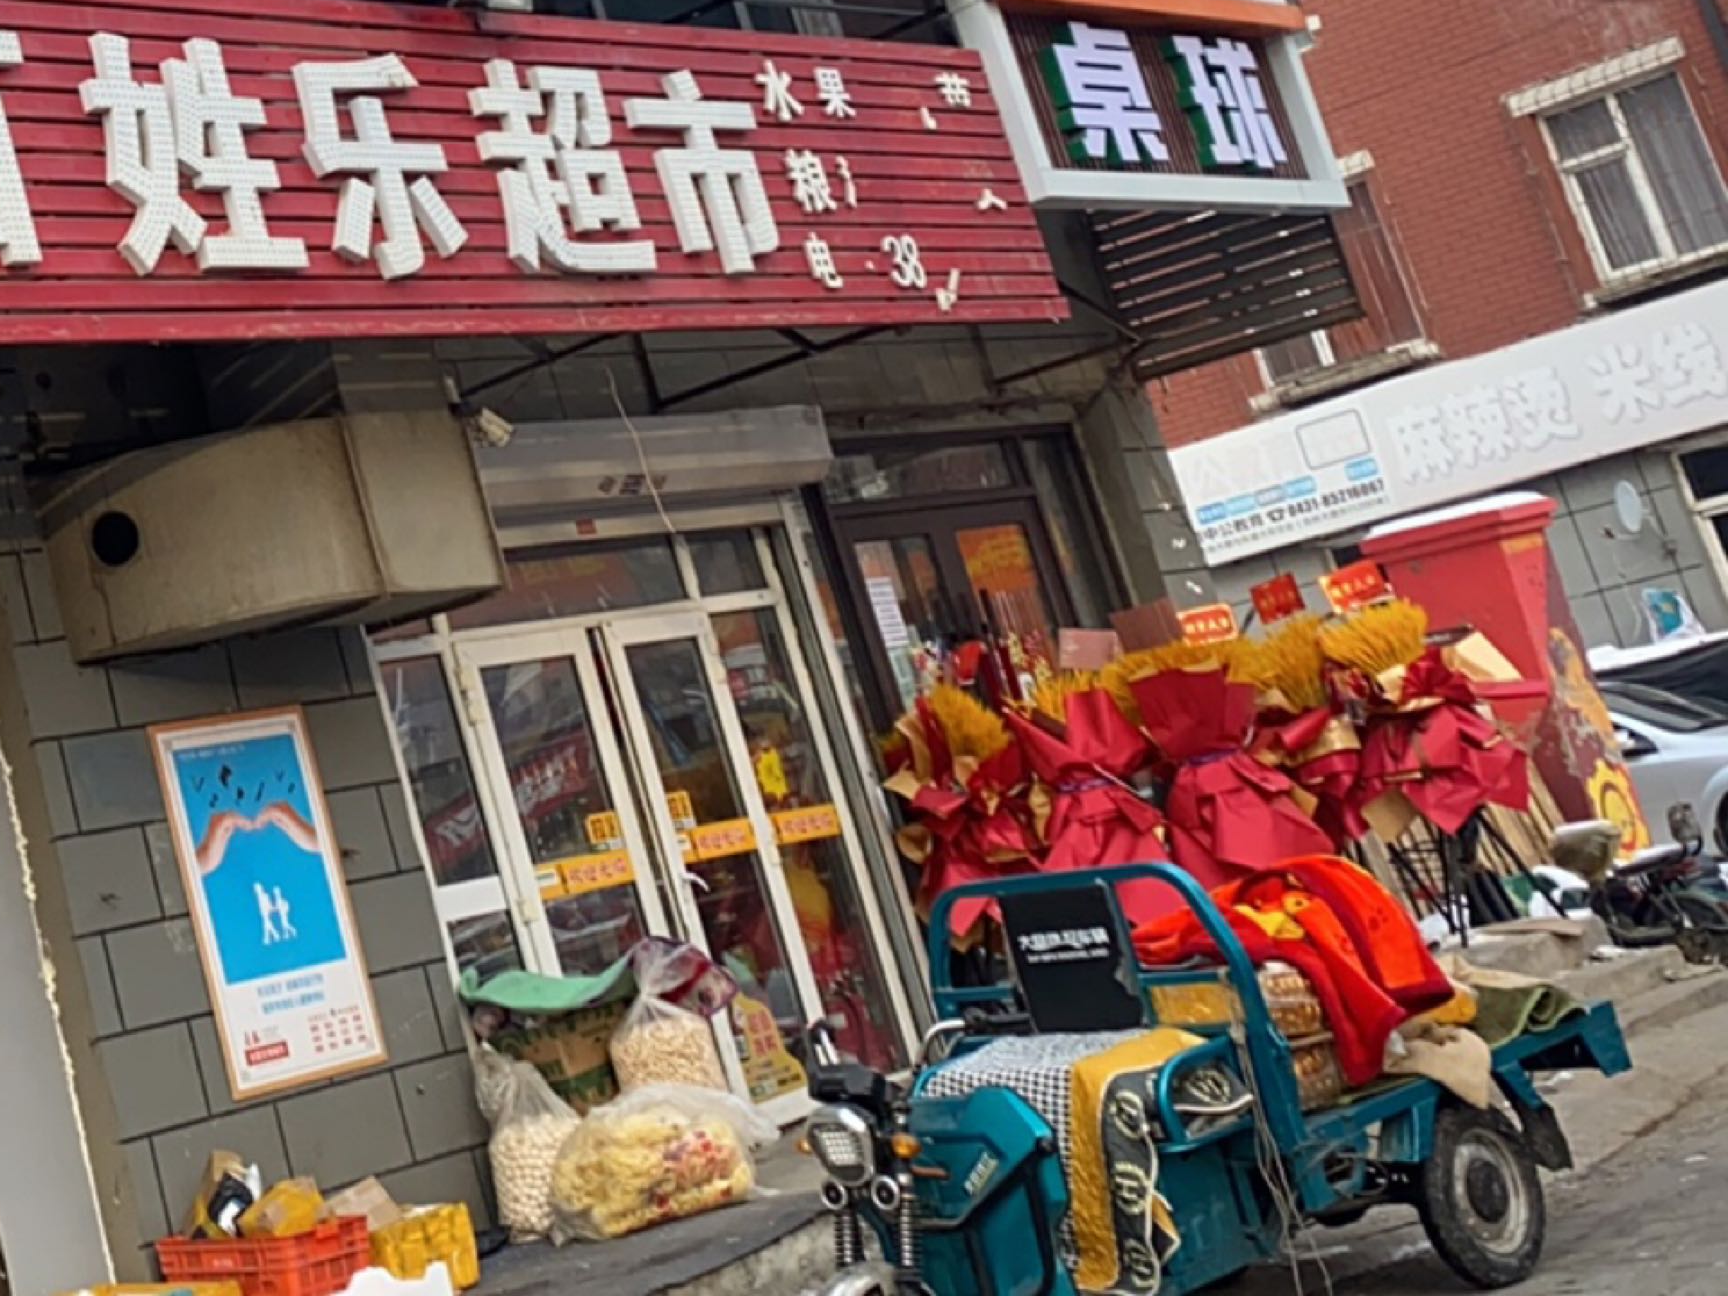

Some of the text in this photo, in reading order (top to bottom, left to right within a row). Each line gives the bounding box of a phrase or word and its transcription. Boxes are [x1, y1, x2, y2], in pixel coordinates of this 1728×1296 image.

[754, 59, 857, 122] 水果
[1042, 21, 1288, 170] 桌球
[1388, 318, 1728, 485] 麻辣烫 米线
